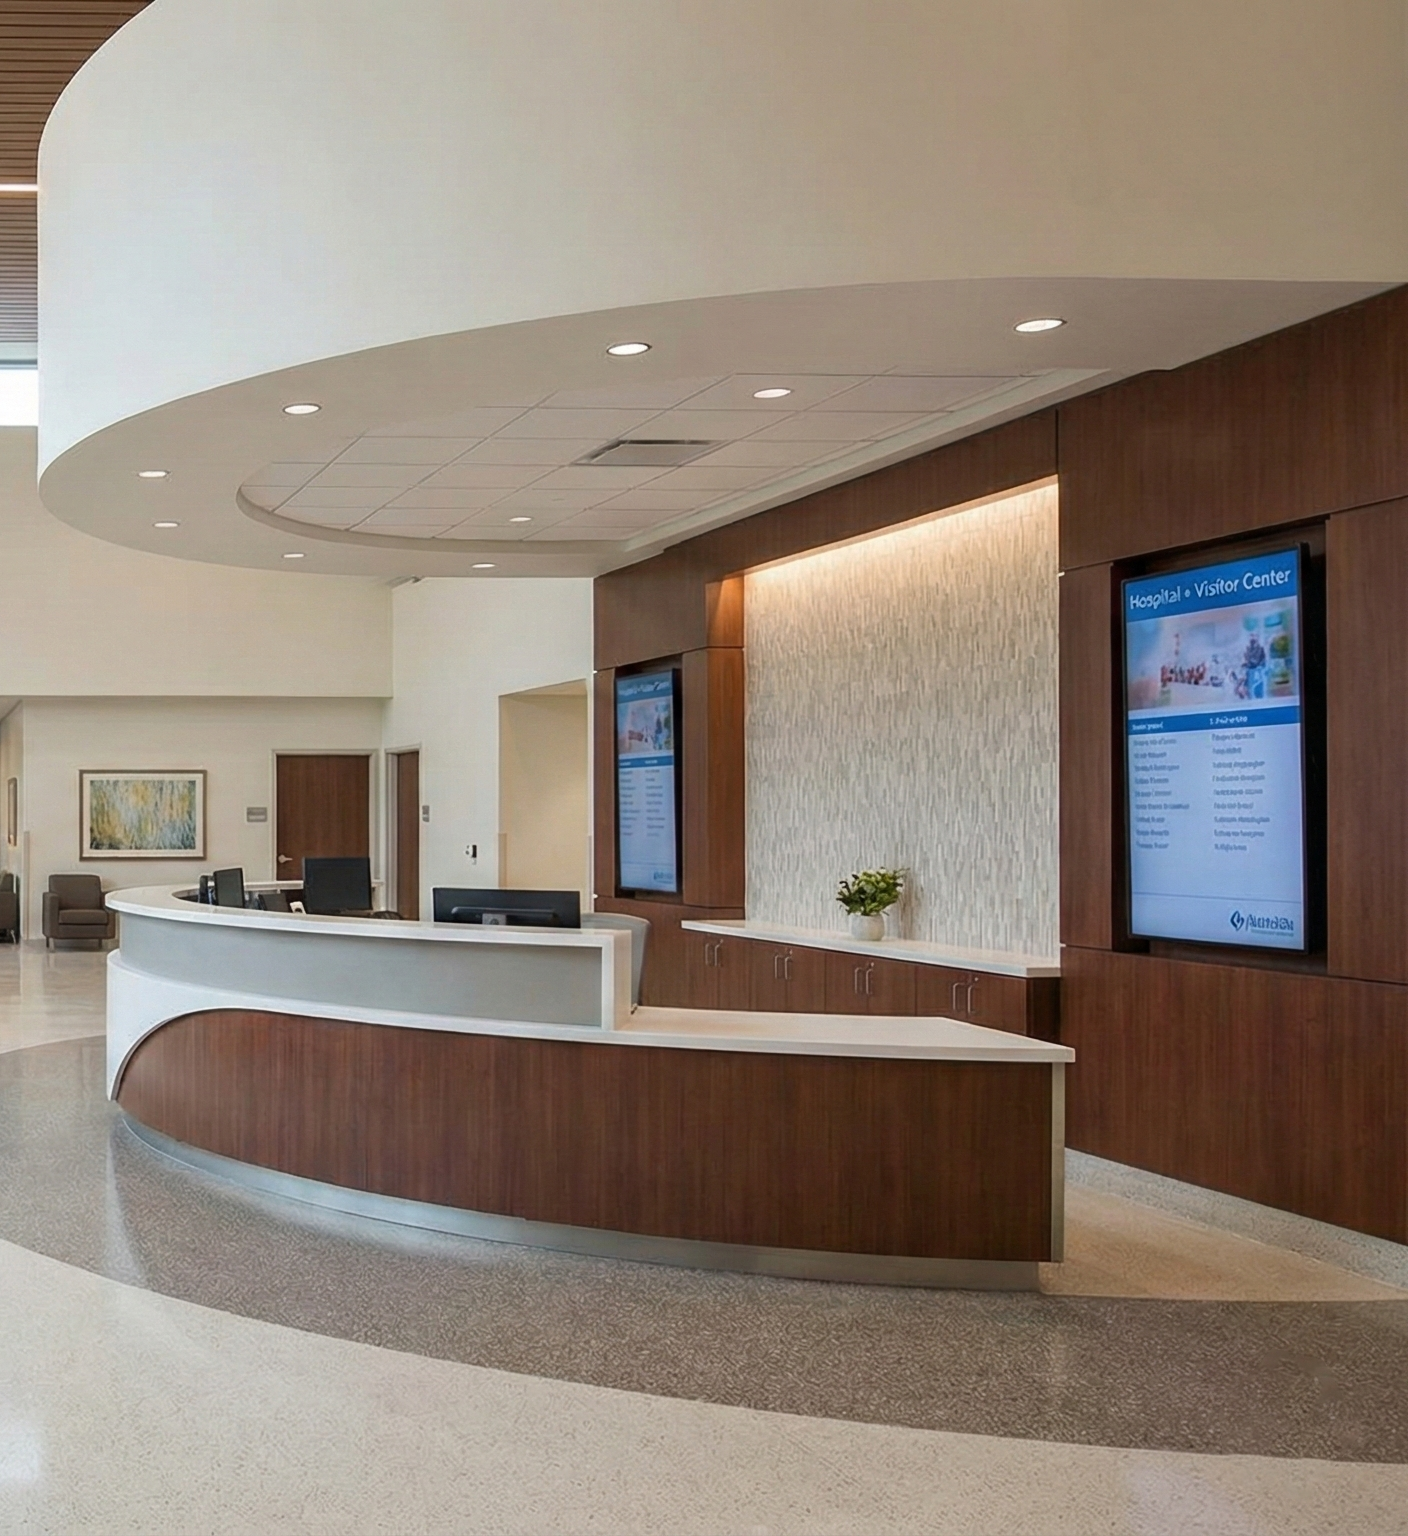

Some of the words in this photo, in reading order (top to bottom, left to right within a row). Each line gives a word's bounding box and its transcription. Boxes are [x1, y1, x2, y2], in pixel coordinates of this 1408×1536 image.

[1130, 586, 1181, 609] Hospital
[1194, 578, 1239, 598] Visitor
[1242, 570, 1291, 590] Center
